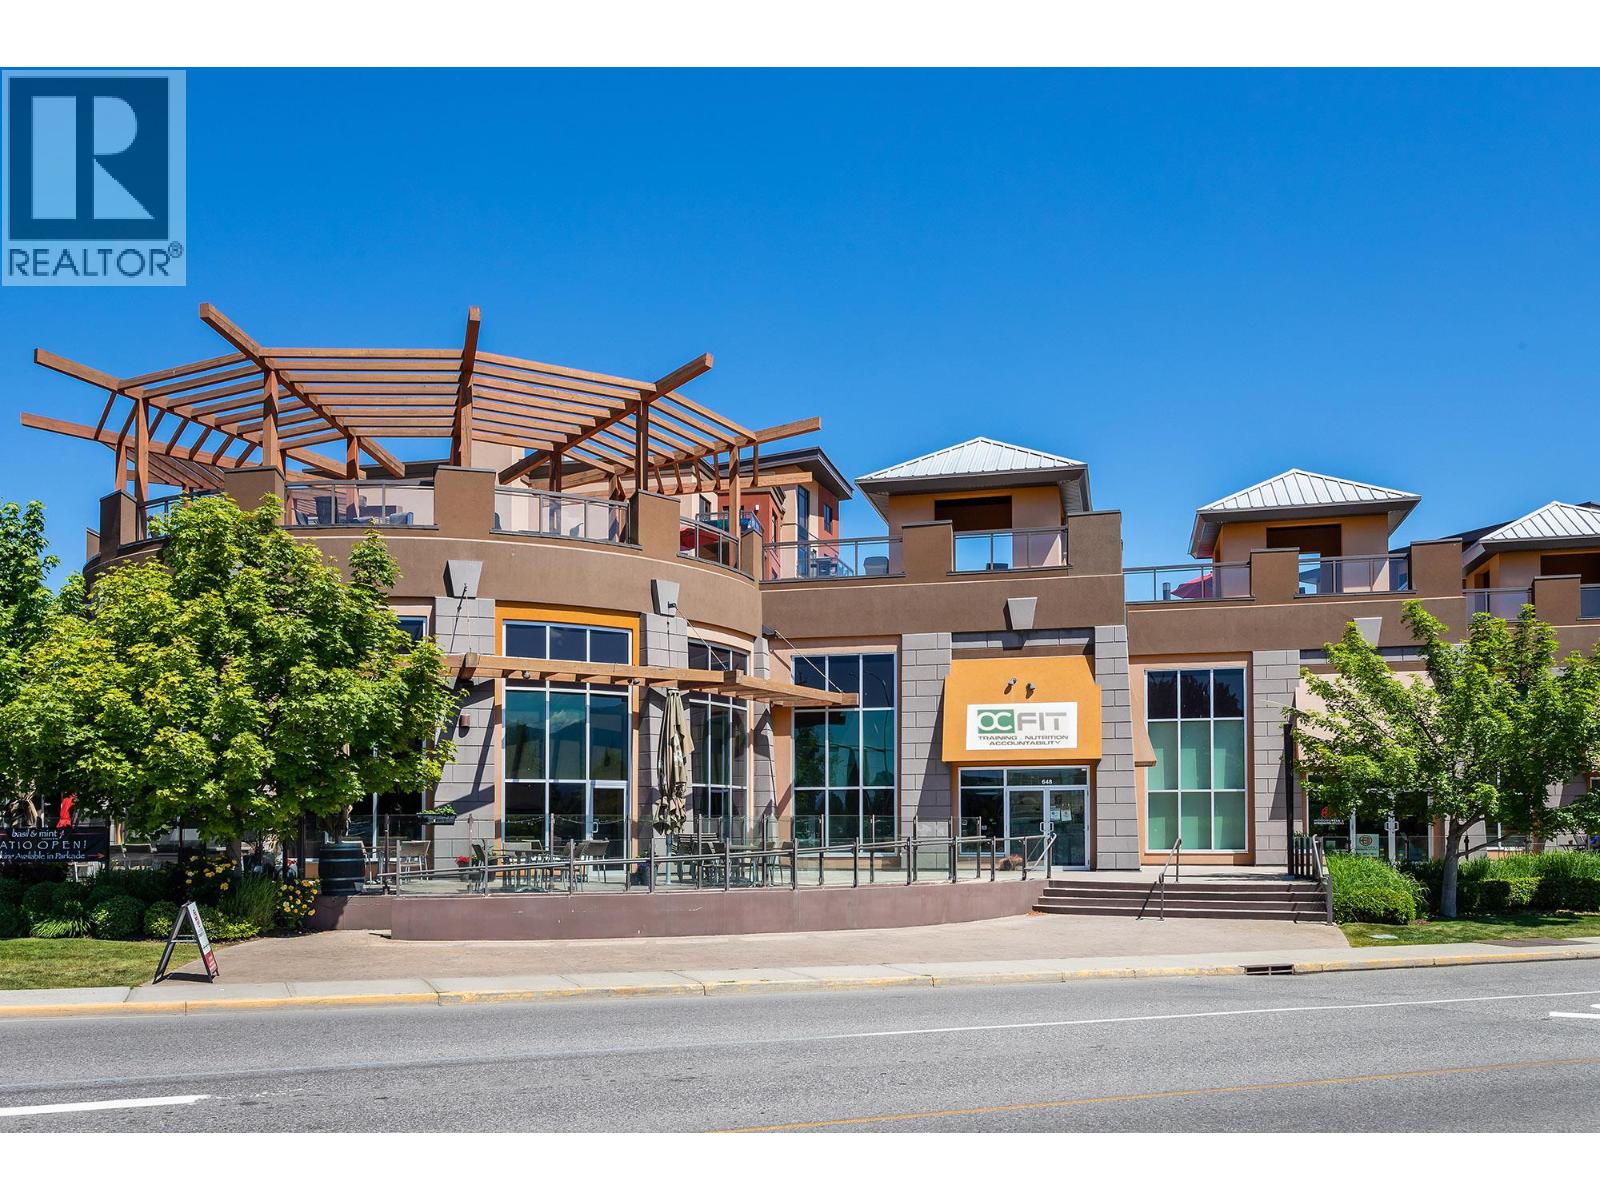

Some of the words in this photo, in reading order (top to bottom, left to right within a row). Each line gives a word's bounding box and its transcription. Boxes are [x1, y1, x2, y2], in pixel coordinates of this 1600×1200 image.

[11, 828, 30, 838] basil
[39, 829, 58, 838] mint
[37, 839, 87, 850] OPEN!
[46, 852, 54, 860] in
